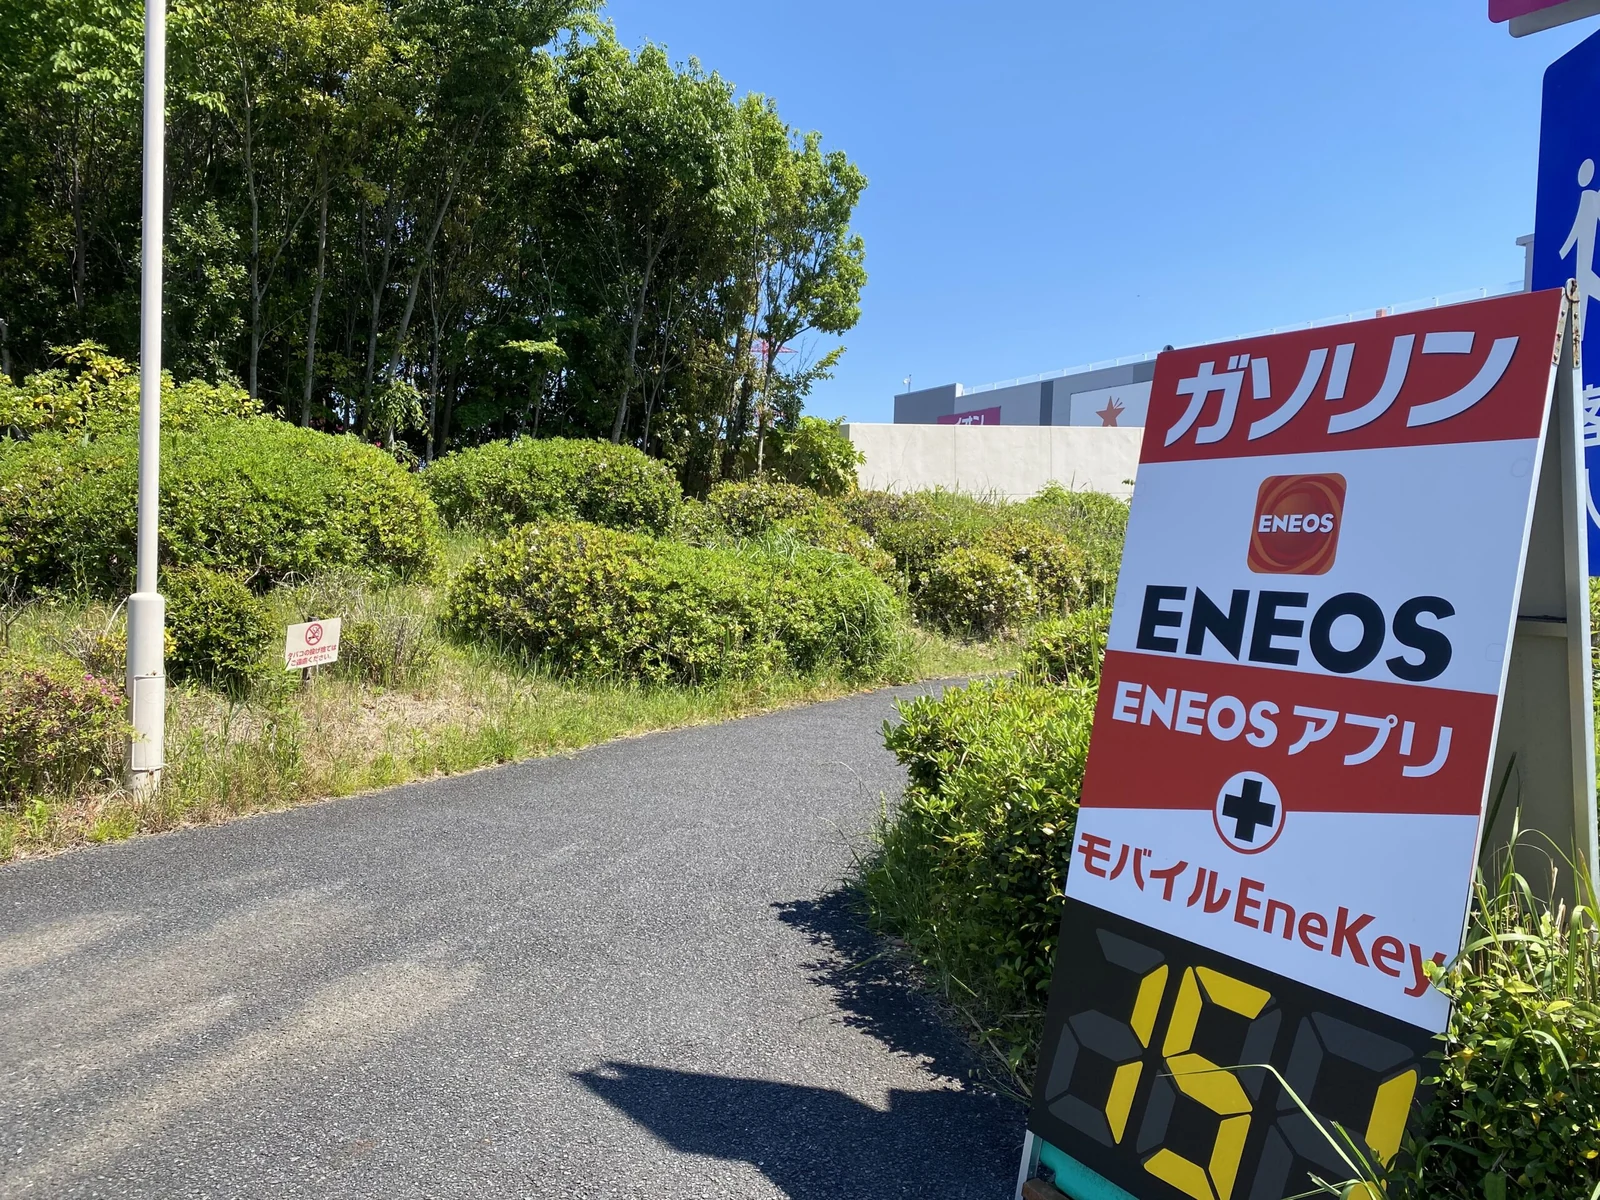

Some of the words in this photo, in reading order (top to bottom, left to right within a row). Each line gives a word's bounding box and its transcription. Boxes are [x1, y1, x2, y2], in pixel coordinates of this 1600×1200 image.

[1164, 332, 1519, 447] ガソリン
[1257, 513, 1334, 534] ENEOS
[1136, 584, 1456, 682] ENEOS
